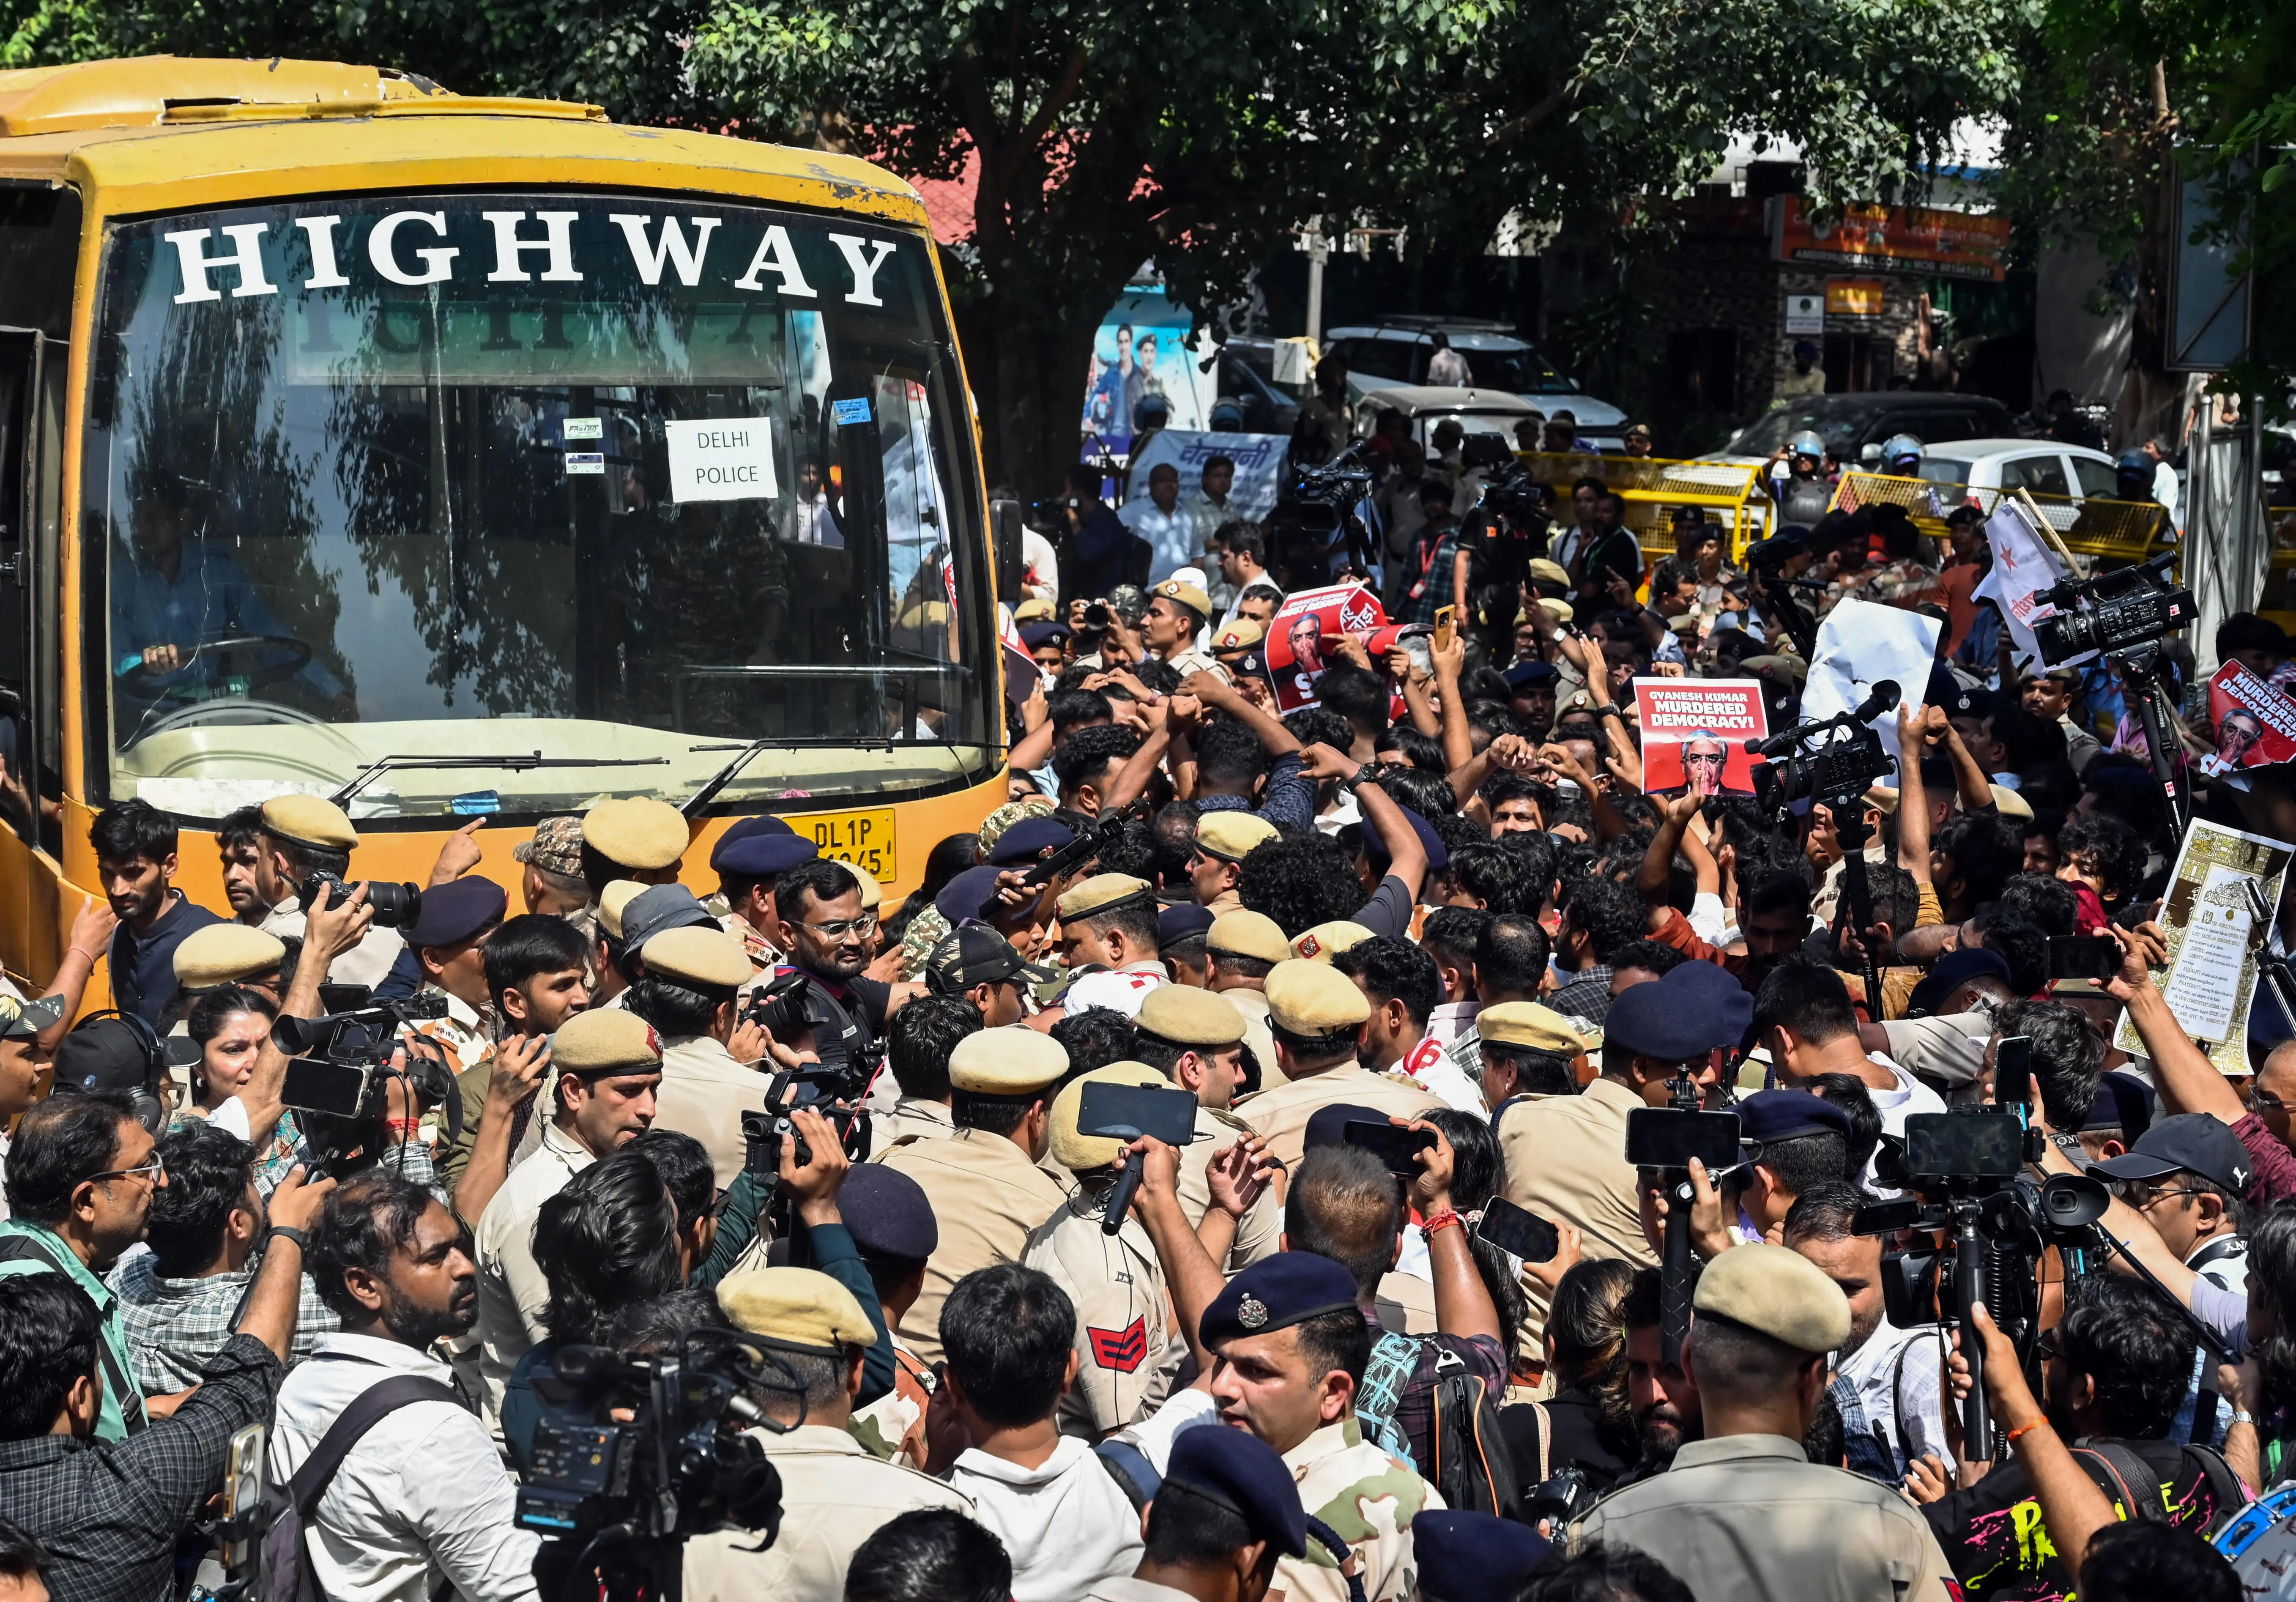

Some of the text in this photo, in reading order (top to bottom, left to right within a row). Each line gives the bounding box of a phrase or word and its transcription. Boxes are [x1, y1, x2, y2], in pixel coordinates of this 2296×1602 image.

[164, 211, 897, 307] HIGHWAY
[698, 431, 749, 448] DELHI
[696, 466, 758, 484] POLICE
[1649, 691, 1748, 702] GYANESH KUMAR
[1654, 701, 1746, 715] MURDERED
[1650, 714, 1755, 728] DEMOCRACY!
[815, 819, 871, 849] DL1P
[2183, 967, 2201, 975] EQUALITY
[2178, 980, 2201, 990] FRATERNITY
[2187, 998, 2208, 1007] CONSTITUENT
[1565, 1483, 1577, 1505] Nikon
[192, 1586, 202, 1601] hp
